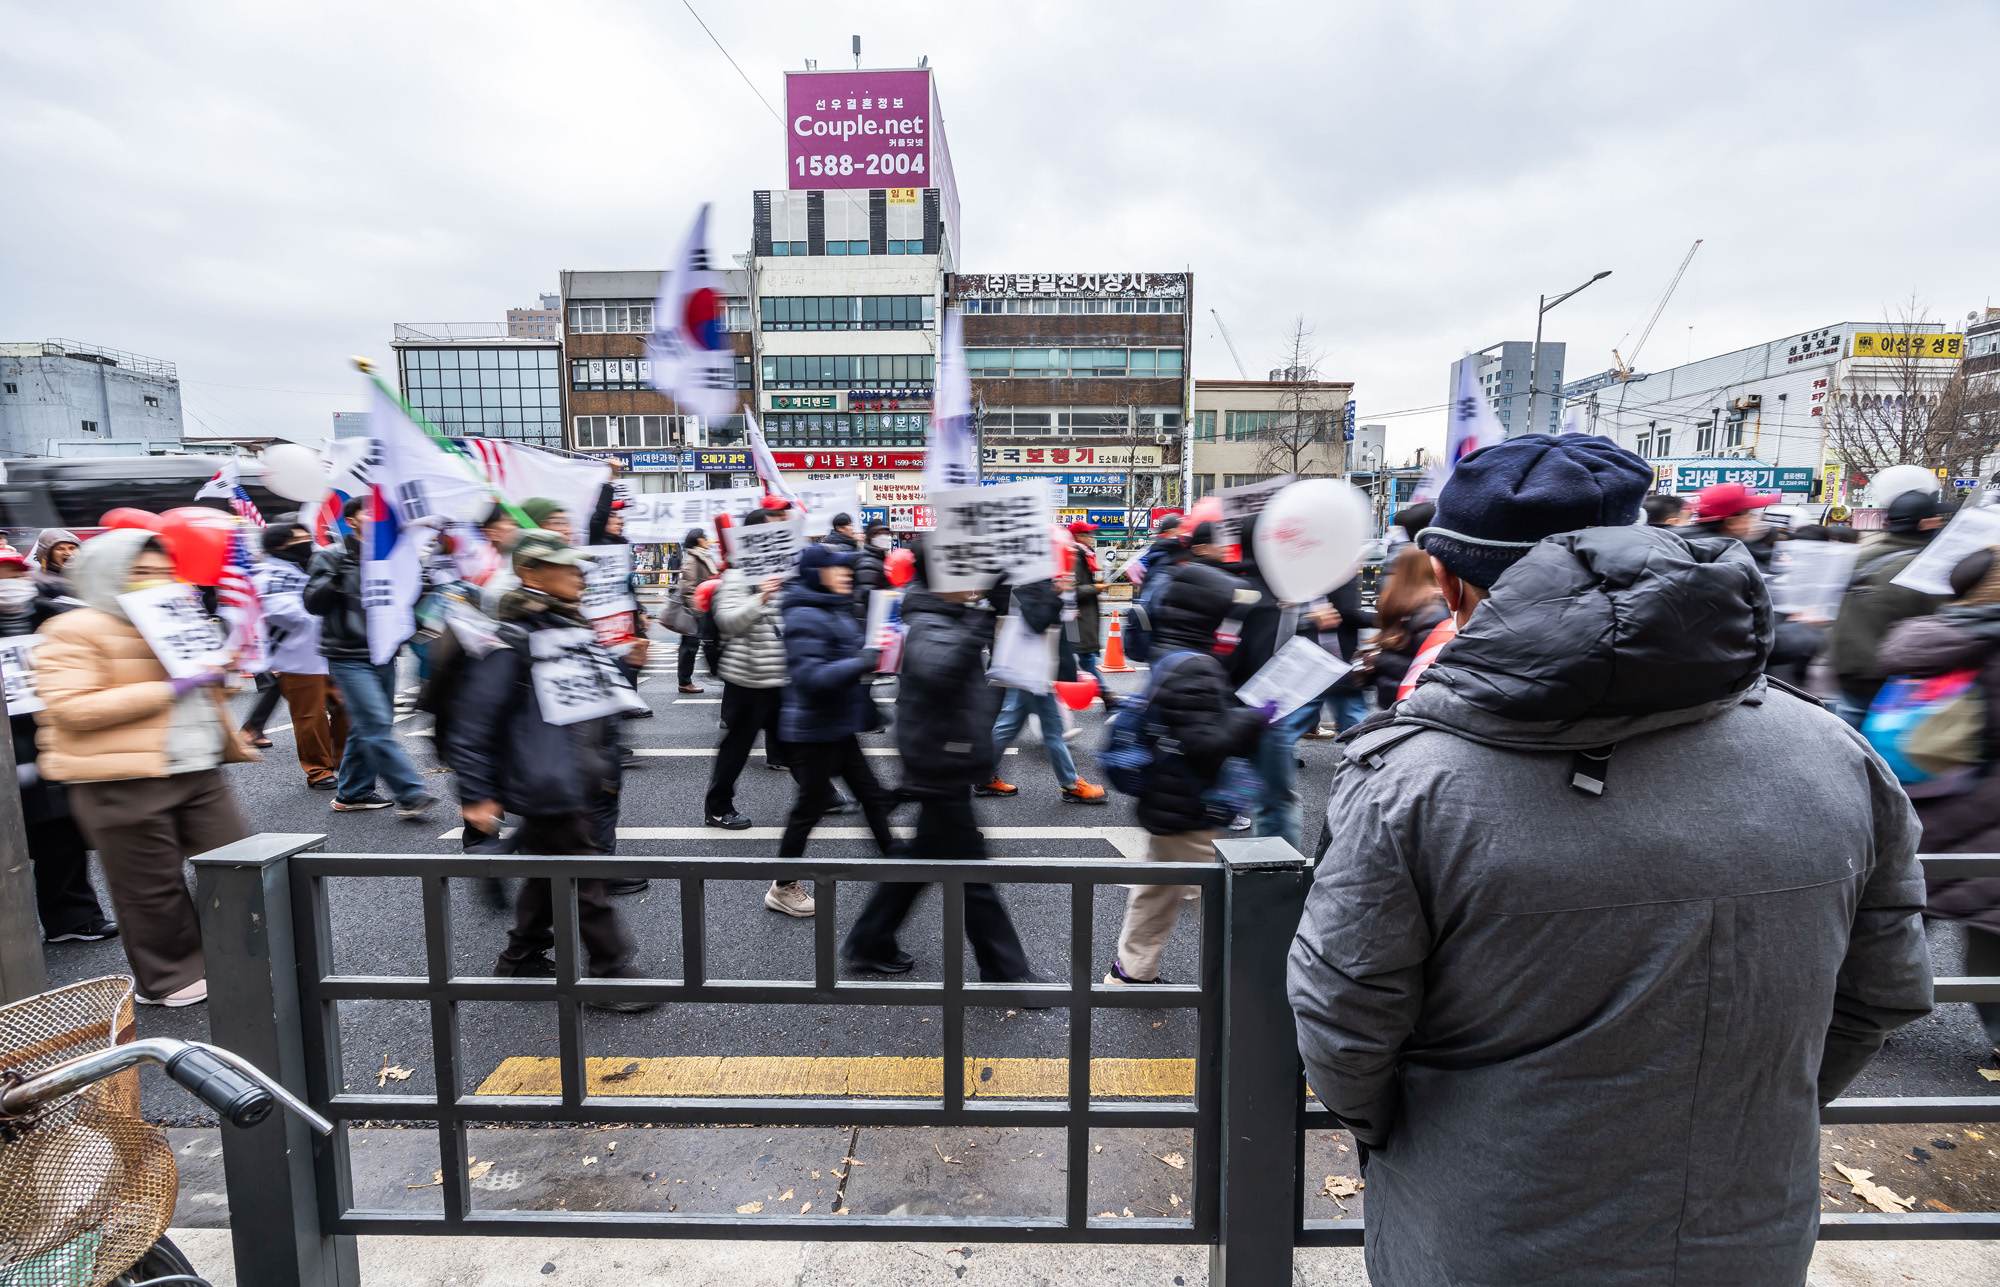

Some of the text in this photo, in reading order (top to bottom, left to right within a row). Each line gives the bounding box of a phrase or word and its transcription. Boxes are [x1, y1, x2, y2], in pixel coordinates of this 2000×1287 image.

[794, 114, 924, 142] Couple.net
[888, 138, 924, 147] 커플닷넷
[795, 153, 925, 176] 1588-2004
[1881, 337, 1926, 353] 이선우
[1932, 338, 1961, 354] 성형
[792, 397, 831, 408] 메디랜드
[701, 453, 746, 464] 오메가 과학
[820, 455, 888, 468] 나눔보청기
[1026, 448, 1095, 464] 보청기
[1071, 486, 1123, 495] T.2274-3755
